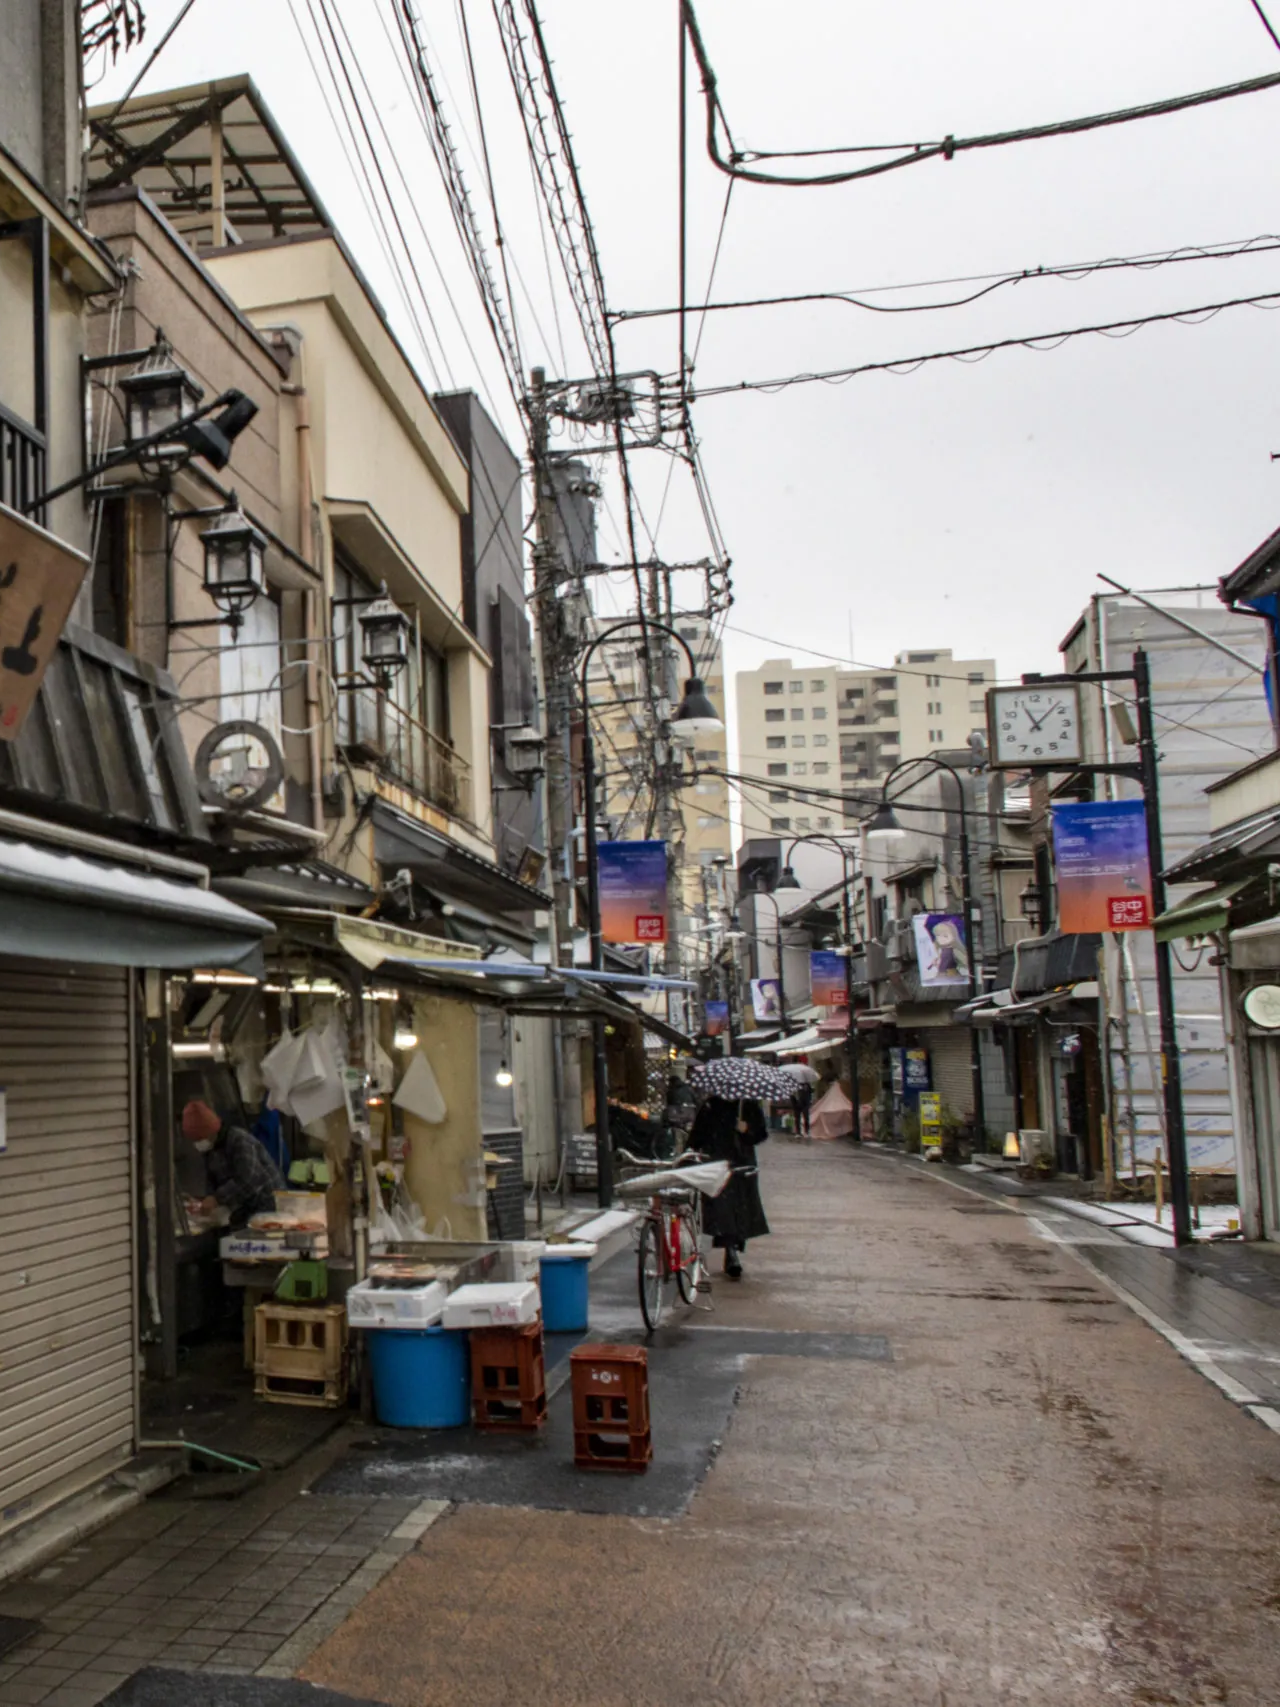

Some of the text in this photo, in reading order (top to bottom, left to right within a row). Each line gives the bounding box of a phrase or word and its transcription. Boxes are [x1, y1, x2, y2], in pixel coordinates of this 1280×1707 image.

[1029, 695, 1040, 703] 12
[1057, 706, 1066, 714] 2
[1005, 711, 1017, 719] 10
[1002, 722, 1011, 731] 9
[1062, 719, 1071, 728] 3
[1006, 734, 1016, 743] 8
[1059, 731, 1068, 740] 4
[1019, 744, 1028, 753] 7
[1049, 742, 1058, 751] 5
[1033, 747, 1043, 756] 6
[1112, 901, 1142, 912] 谷中
